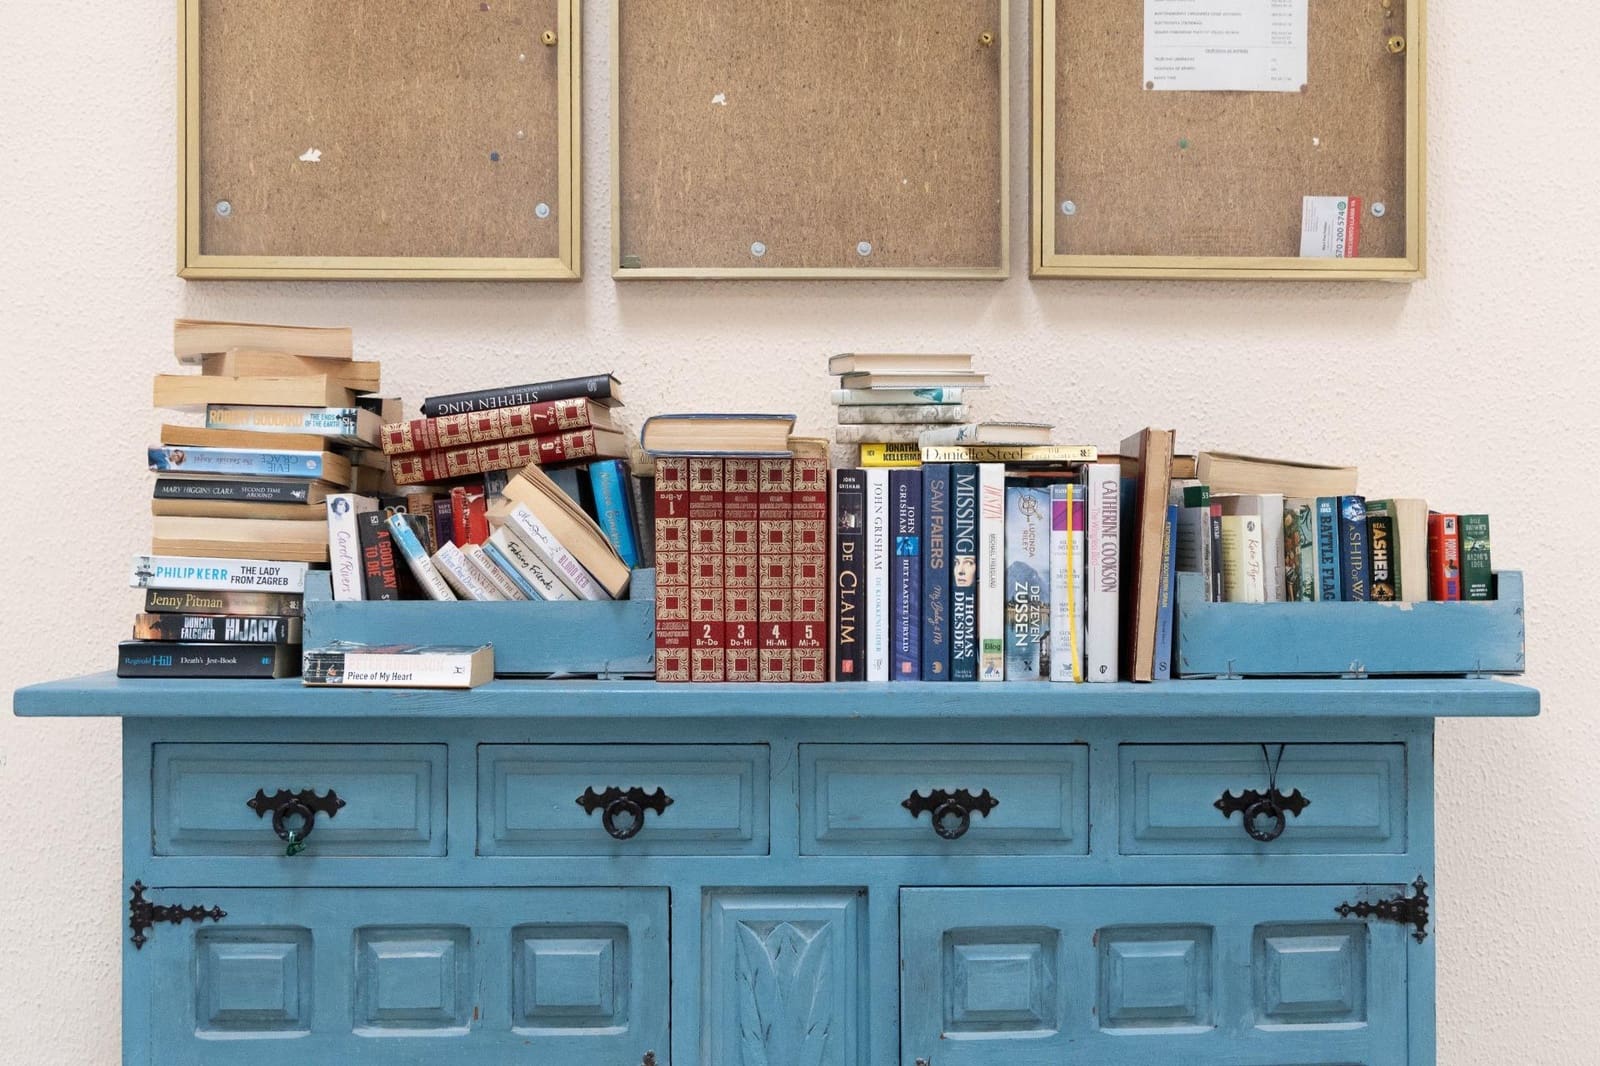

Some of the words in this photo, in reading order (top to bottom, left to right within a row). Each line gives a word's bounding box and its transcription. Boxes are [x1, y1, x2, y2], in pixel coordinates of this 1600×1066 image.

[1337, 211, 1345, 226] 574
[438, 402, 474, 414] KING
[479, 391, 539, 408] STEPHEN
[321, 413, 336, 421] ENDS
[323, 420, 340, 428] EARTH
[541, 442, 554, 450] 6
[885, 443, 920, 452] JONATHA
[926, 447, 983, 460] Danielle
[985, 447, 1024, 460] Steel
[261, 453, 299, 464] GRACE
[883, 453, 922, 462] KELLERMA
[266, 461, 290, 473] EVIE
[161, 486, 181, 494] MARY
[183, 486, 209, 495] HIGGINS
[211, 487, 234, 495] CLARK
[873, 483, 883, 514] JOHN
[930, 480, 944, 514] SAM
[668, 501, 675, 515] 1
[899, 484, 907, 534] GRISHAM
[956, 474, 975, 553] MISSING
[1101, 480, 1118, 539] CATHERINE
[907, 506, 915, 534] JOHN
[377, 531, 389, 539] A
[930, 516, 944, 570] FAIERS
[1320, 516, 1334, 565] BATTLE
[337, 531, 353, 560] Carol
[365, 545, 378, 558] TO
[842, 542, 855, 562] DE
[873, 518, 883, 570] GRISHAM
[1349, 532, 1363, 570] SHIP
[378, 541, 394, 567] GOOD
[1374, 529, 1389, 581] ASHER
[156, 565, 195, 580] PHILIP
[196, 567, 228, 581] KERR
[240, 565, 257, 575] THE
[258, 566, 281, 576] LADY
[366, 561, 381, 578] DIE
[507, 541, 530, 568] Faking
[529, 564, 553, 591] Friends
[1101, 541, 1117, 593] COOKSON
[230, 575, 255, 585] FROM
[256, 576, 289, 586] ZAGREB
[339, 561, 354, 593] Rivers
[383, 568, 397, 589] DAY
[1322, 567, 1336, 600] FLAG
[1351, 569, 1359, 581] OF
[1030, 585, 1040, 597] DE
[1351, 580, 1364, 601] WA
[150, 591, 183, 608] Jenny
[186, 594, 223, 609] Pitman
[839, 570, 858, 645] CLAIM
[184, 616, 214, 629] DUNCAN
[1015, 582, 1028, 647] ZUSSEN
[1030, 600, 1041, 643] ZEVEN
[180, 626, 216, 641] FALCONER
[225, 618, 278, 643] HIJACK
[703, 624, 711, 638] 2
[737, 624, 745, 638] 3
[771, 624, 780, 638] 4
[805, 624, 813, 638] 5
[954, 592, 965, 660] DRESDEN
[965, 593, 974, 658] THOMAS
[152, 653, 173, 667] Hill
[180, 656, 203, 664] Death's
[204, 656, 238, 666] Jest-Book
[347, 671, 369, 681] Piece
[370, 671, 378, 680] of
[379, 671, 391, 683] My
[391, 672, 413, 682] Heart
